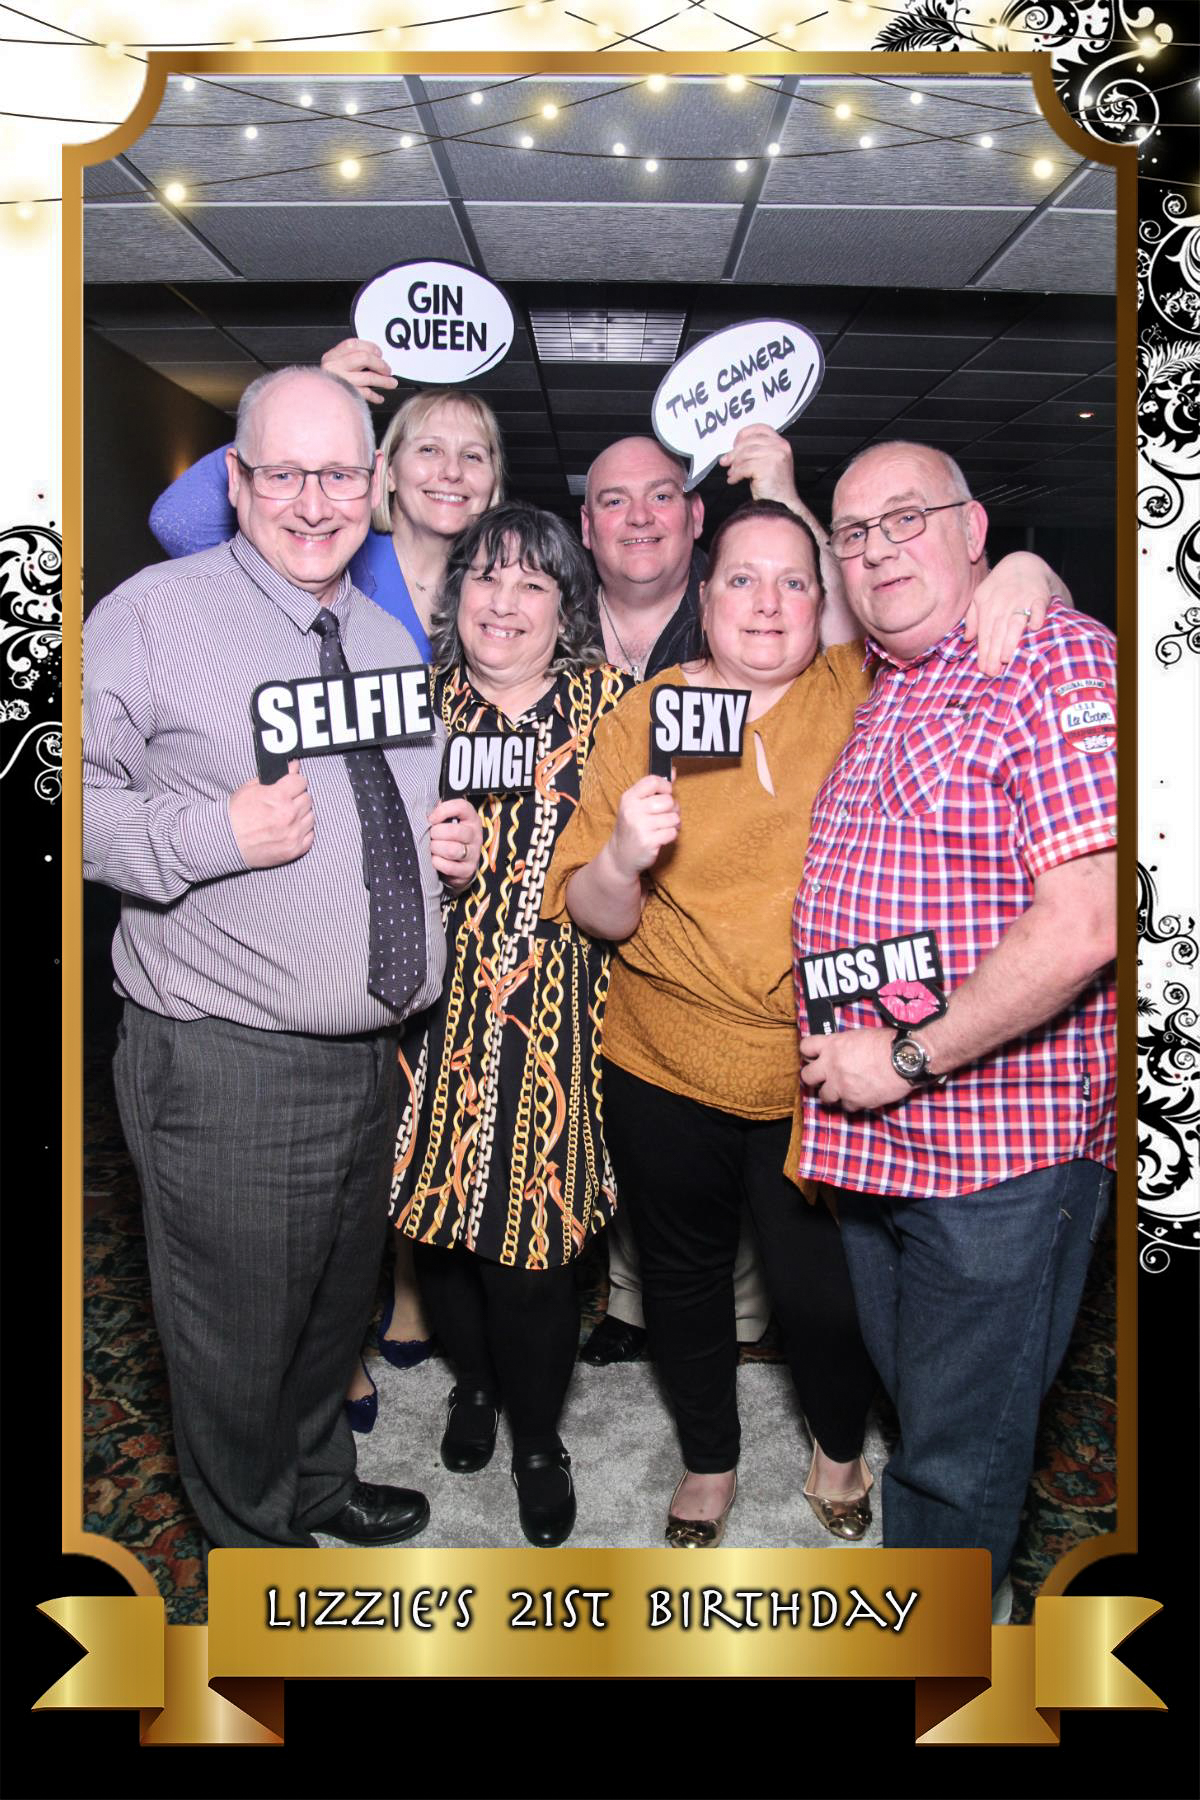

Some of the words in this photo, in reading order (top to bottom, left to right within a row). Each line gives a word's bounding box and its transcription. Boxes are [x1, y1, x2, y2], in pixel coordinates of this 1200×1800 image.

[408, 281, 462, 315] GIN
[385, 317, 487, 351] QUEEN
[666, 381, 709, 419] THE
[717, 335, 796, 392] CAMERA
[695, 388, 756, 440] LOVES
[762, 368, 792, 402] ME
[257, 670, 431, 754] SELFIE
[655, 688, 747, 752] SEXY
[449, 736, 535, 791] OMG!
[804, 948, 880, 1000] KISS
[883, 937, 936, 983] ME
